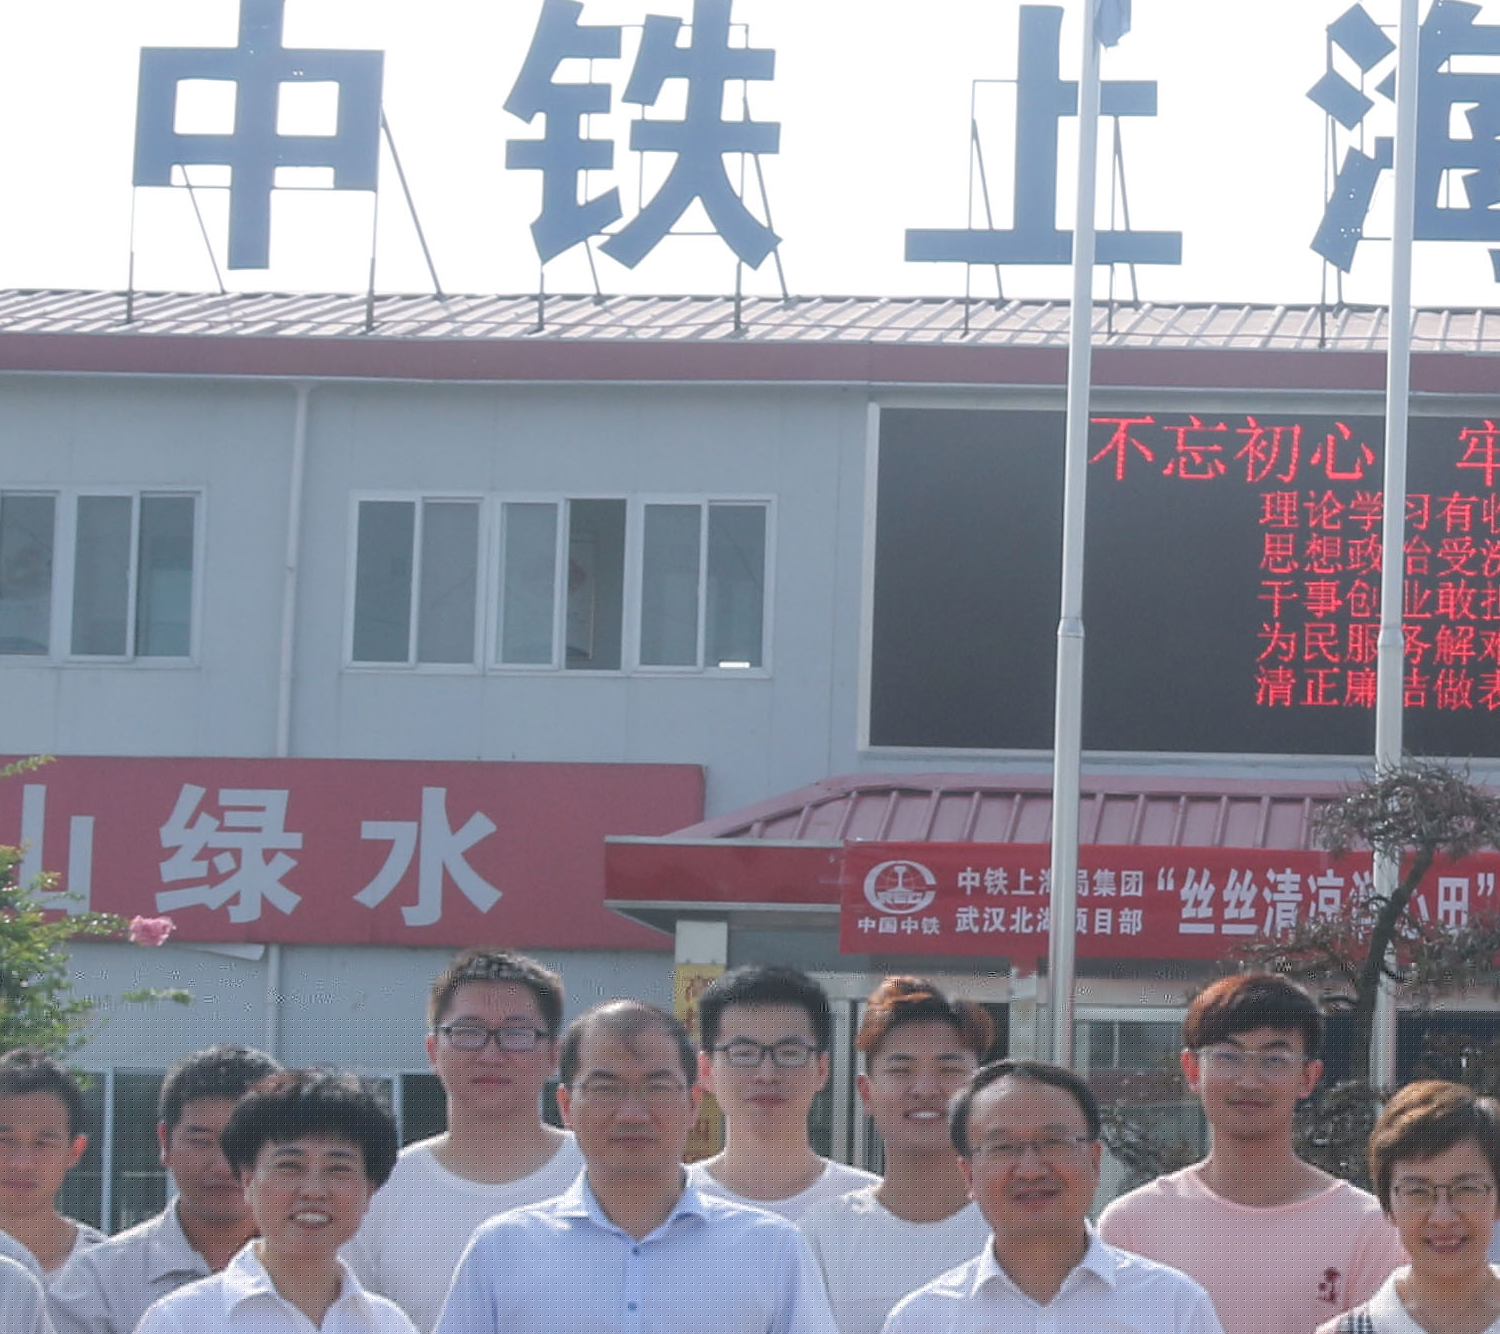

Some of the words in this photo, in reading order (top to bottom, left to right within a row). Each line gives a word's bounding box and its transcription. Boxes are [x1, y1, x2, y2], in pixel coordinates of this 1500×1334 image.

[1088, 415, 1376, 483] 不忘初心
[858, 916, 941, 935] 中国中铁
